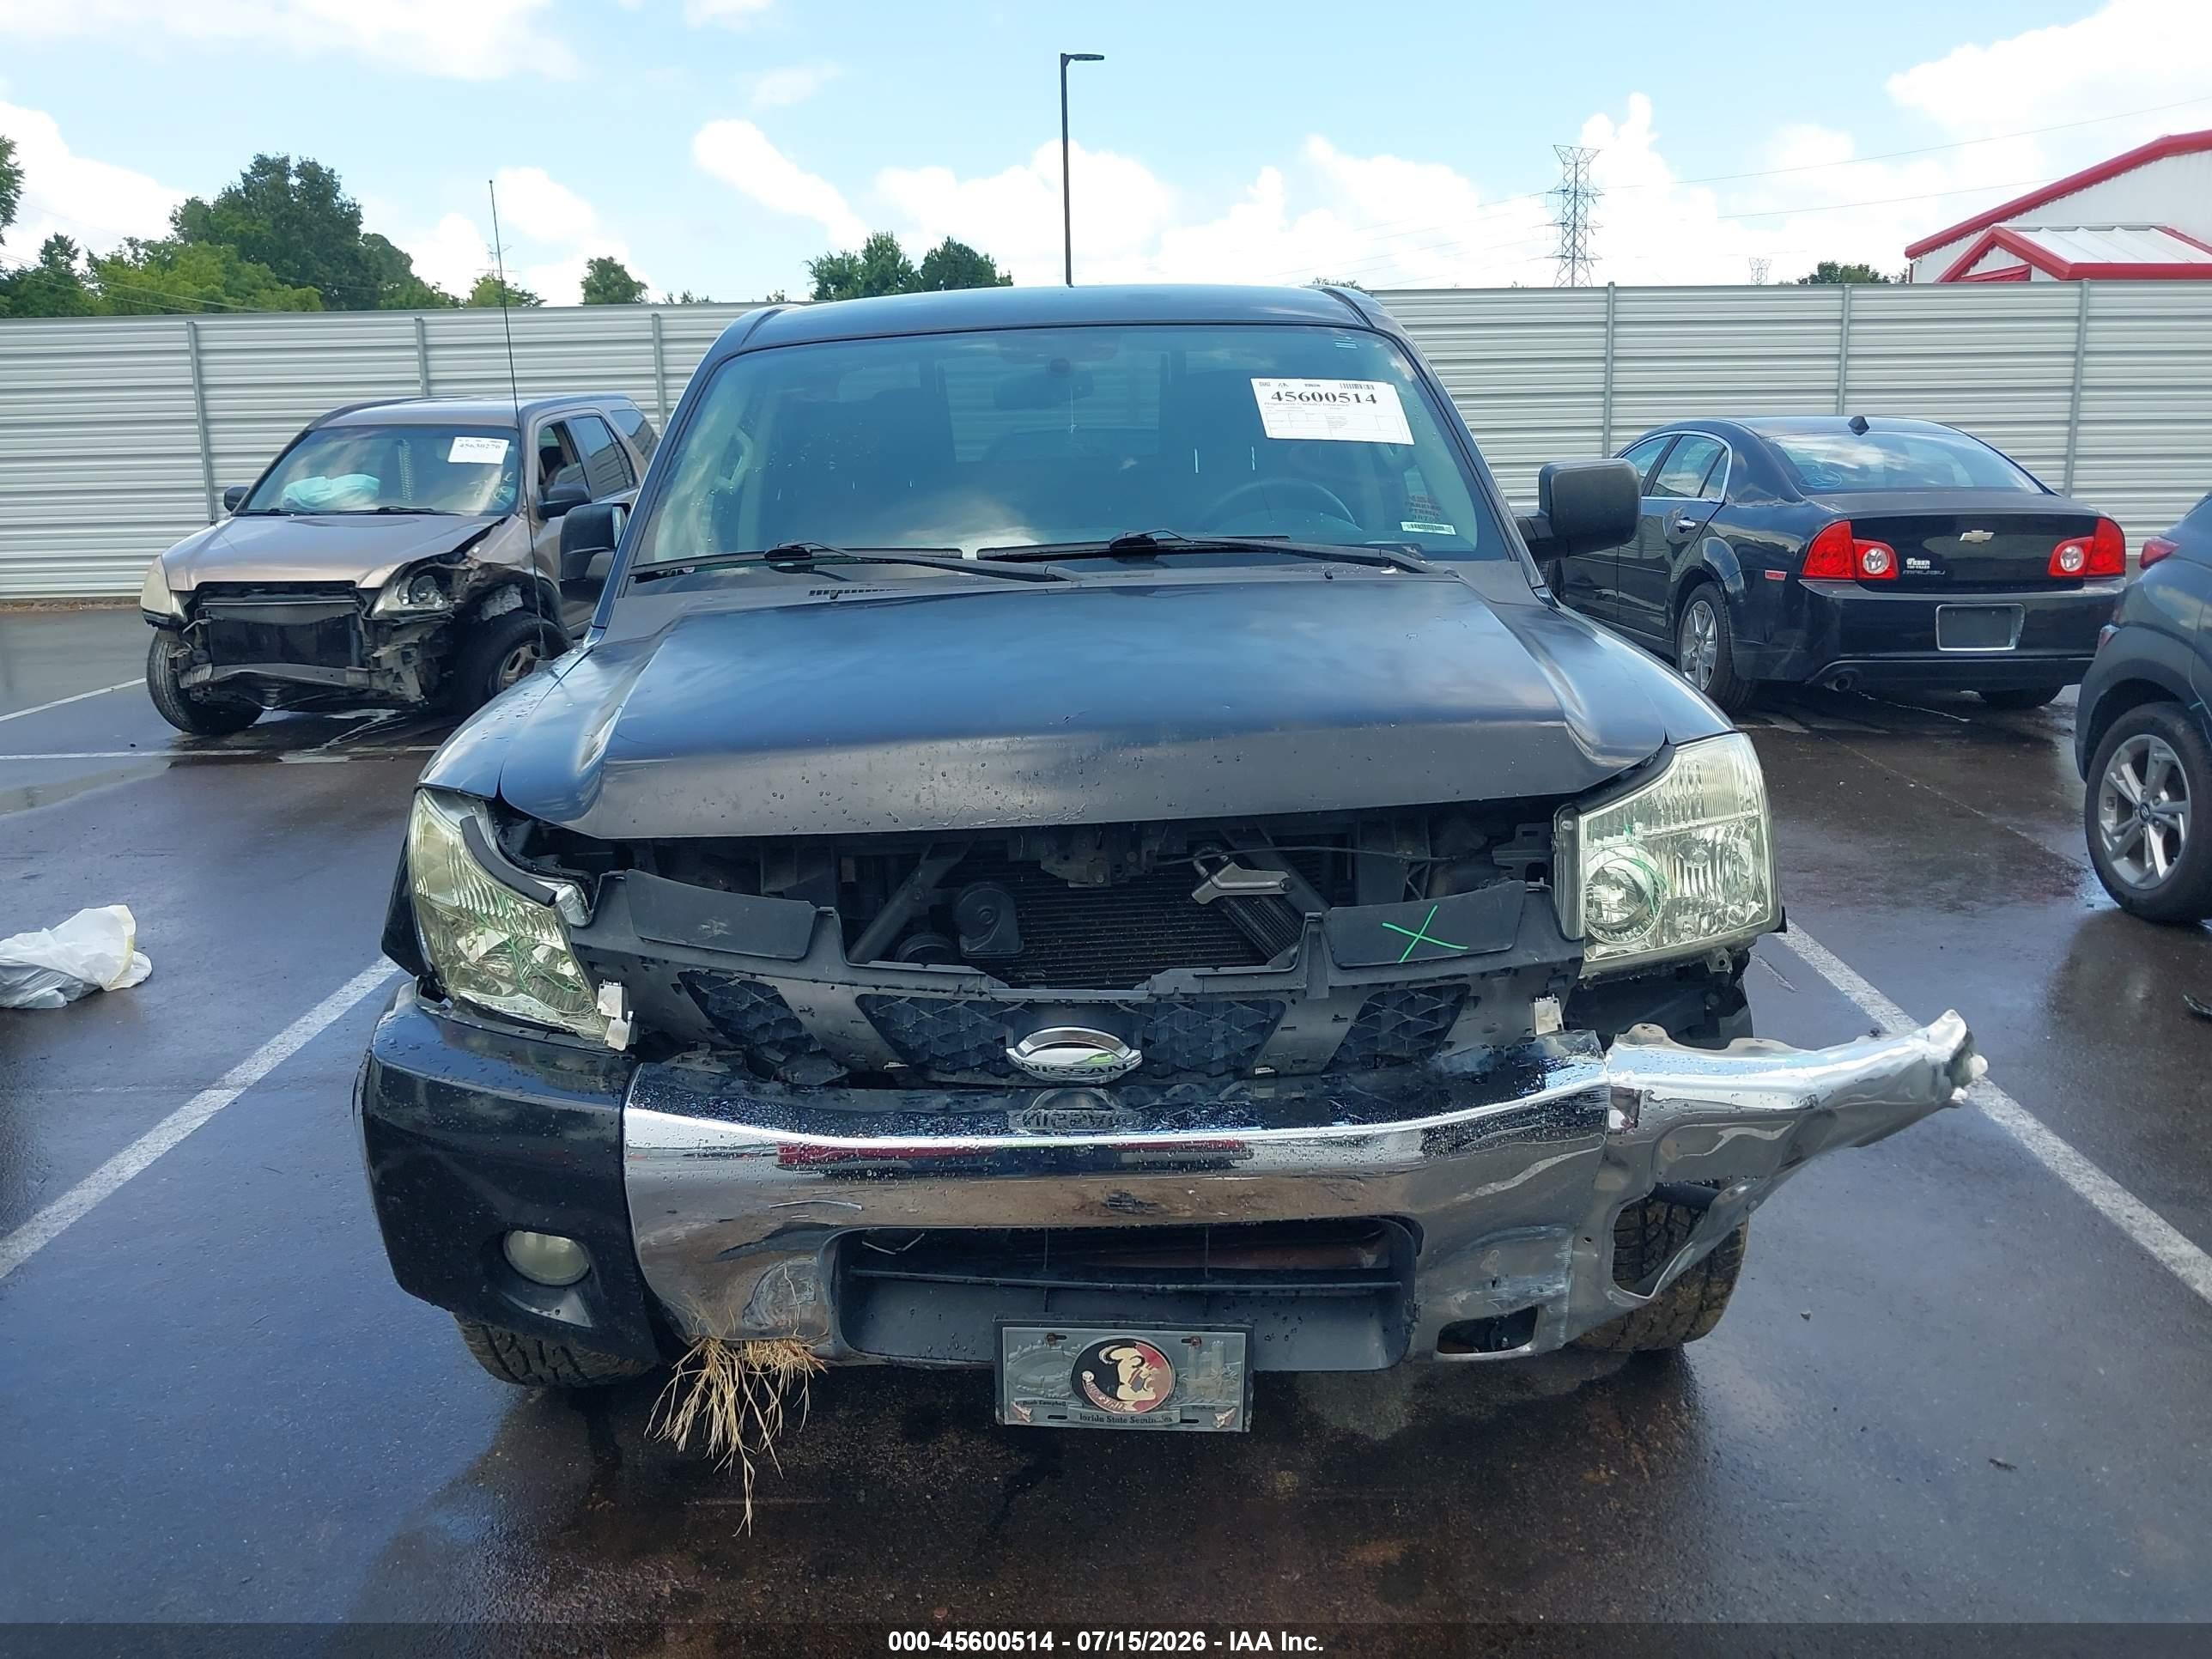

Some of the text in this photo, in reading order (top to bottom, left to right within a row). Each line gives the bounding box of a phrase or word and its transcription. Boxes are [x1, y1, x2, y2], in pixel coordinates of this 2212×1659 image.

[1271, 391, 1377, 404] 45600514
[1020, 1062, 1127, 1074] NISSAN
[1079, 1413, 1173, 1424] lorida State Seminles
